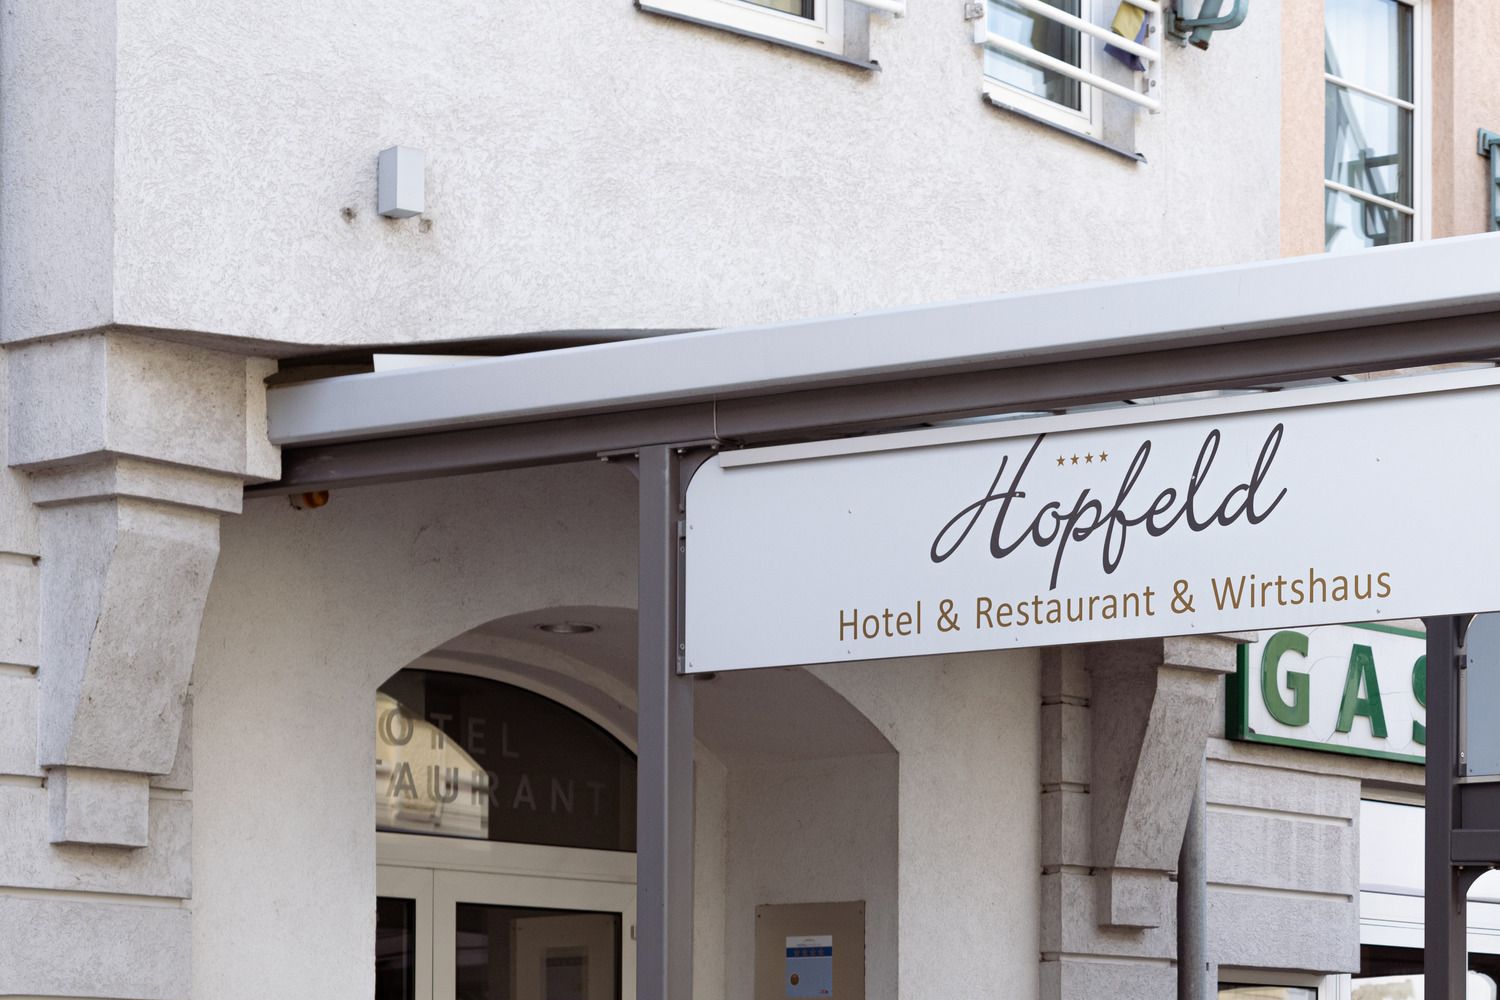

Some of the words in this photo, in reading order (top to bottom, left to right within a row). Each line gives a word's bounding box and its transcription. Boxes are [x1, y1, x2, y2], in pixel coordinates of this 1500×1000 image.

[930, 422, 1289, 591] Hopfeld
[837, 600, 922, 642] Hotel
[936, 597, 961, 633] &
[974, 584, 1156, 630] Restaurant
[1170, 579, 1196, 614] &
[1211, 567, 1392, 611] Wirtshaus
